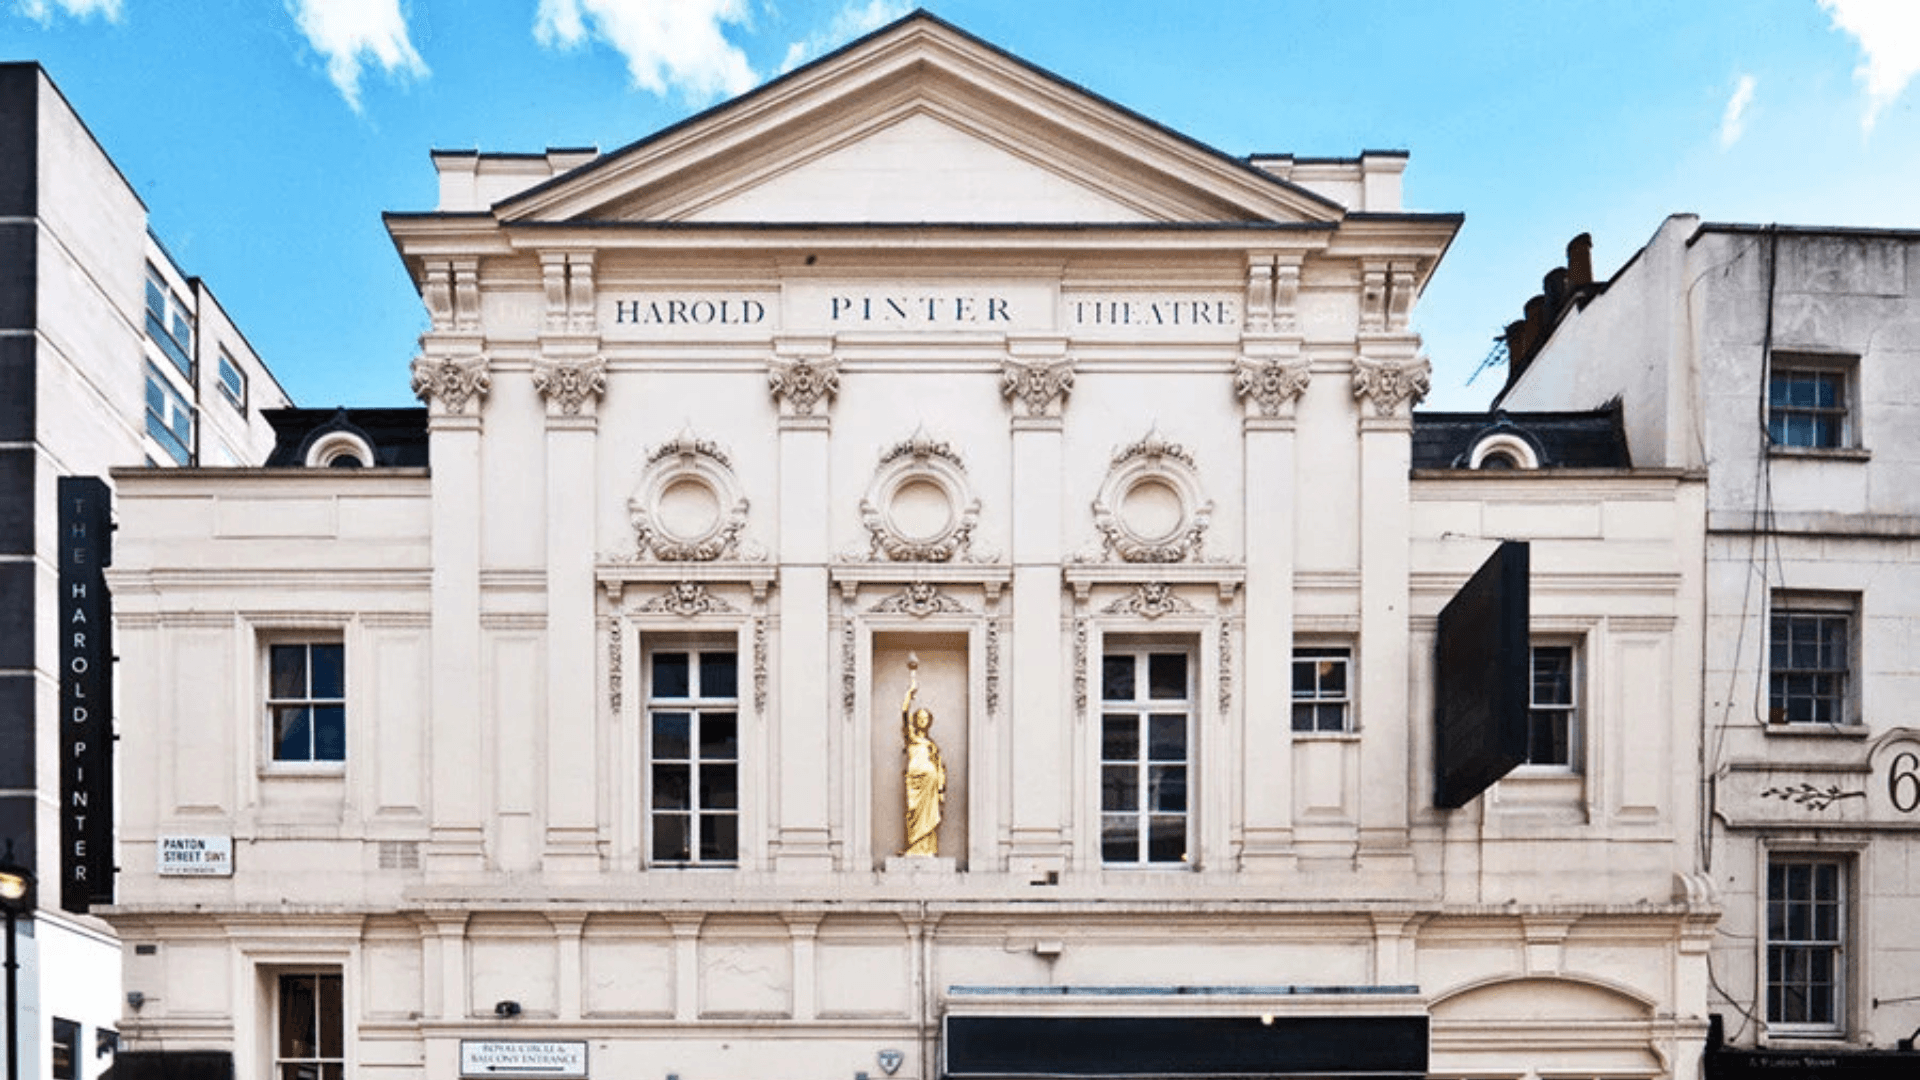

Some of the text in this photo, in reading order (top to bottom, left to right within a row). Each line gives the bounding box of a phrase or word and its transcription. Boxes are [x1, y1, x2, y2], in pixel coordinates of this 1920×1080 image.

[616, 297, 1236, 325] HAROLD PINTER THEATRE
[72, 498, 88, 881] THE HAROLD PINTER
[1889, 752, 1920, 813] 6
[163, 838, 206, 850] PANTON
[163, 850, 226, 862] STREET SW1
[482, 1044, 516, 1053] ROYAL
[518, 1044, 554, 1053] CIRCLE
[471, 1054, 577, 1063] BALCONY ENTRANCE
